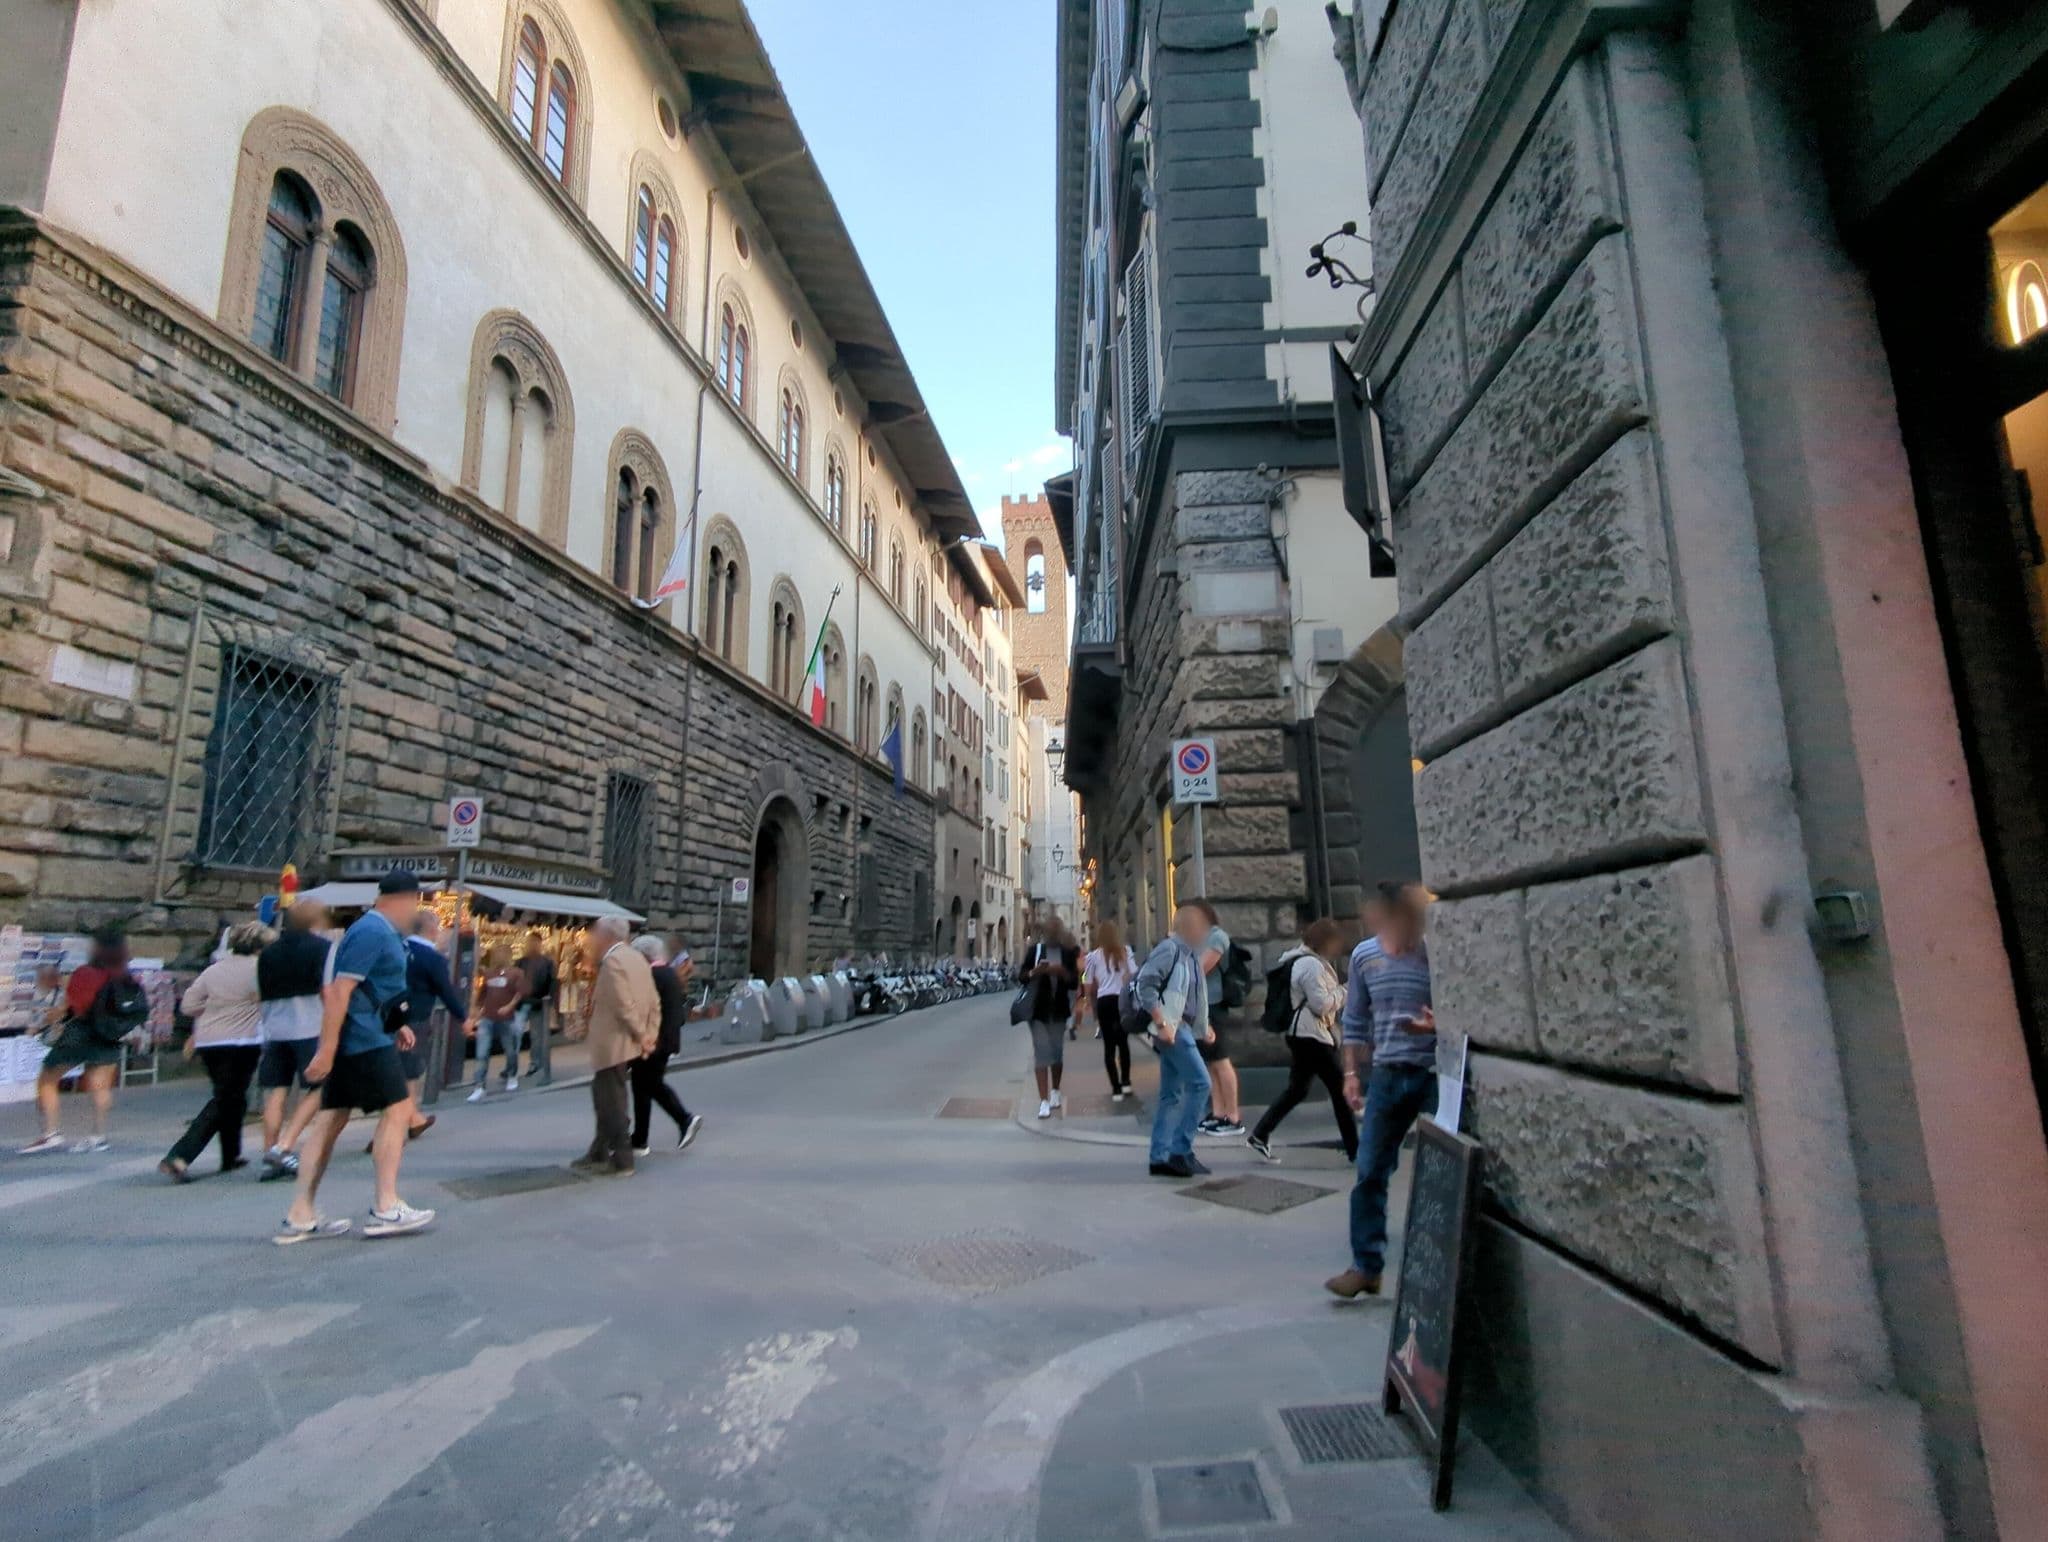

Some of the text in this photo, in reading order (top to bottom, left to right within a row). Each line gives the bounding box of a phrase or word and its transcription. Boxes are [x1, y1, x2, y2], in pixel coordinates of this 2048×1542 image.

[472, 860, 535, 880] LA NAZIONE
[546, 871, 558, 884] LA
